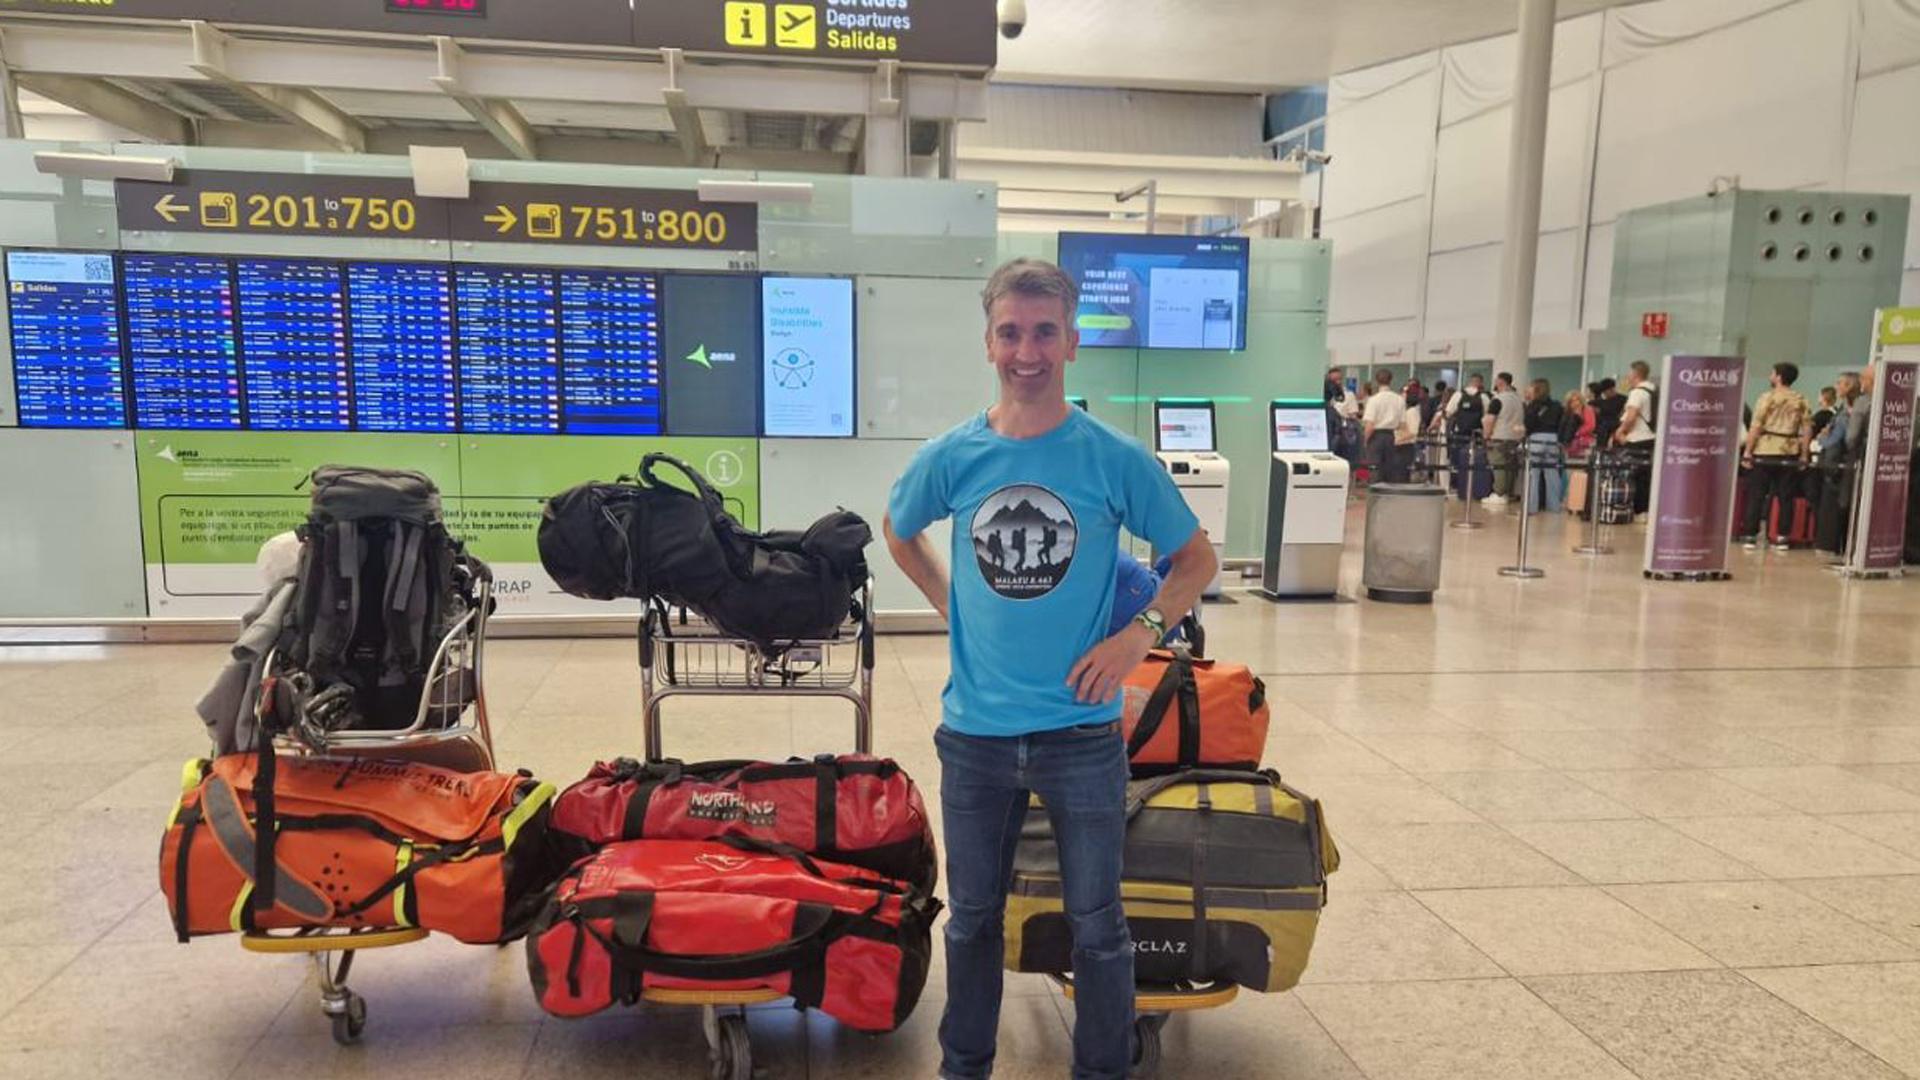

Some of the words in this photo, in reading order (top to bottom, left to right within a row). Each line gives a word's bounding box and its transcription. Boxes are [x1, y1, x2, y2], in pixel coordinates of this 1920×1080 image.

[825, 9, 911, 29] Departures
[827, 30, 897, 51] Salidas
[248, 195, 320, 228] 201
[325, 199, 339, 211] to
[341, 198, 416, 231] 750
[327, 217, 337, 229] a
[571, 207, 638, 240] 751
[642, 211, 655, 223] to
[657, 210, 726, 243] 800
[644, 229, 653, 240] a
[1679, 369, 1728, 384] QATAR
[1671, 399, 1724, 412] Check-in
[1883, 427, 1900, 441] Bag
[488, 523, 519, 531] puntos
